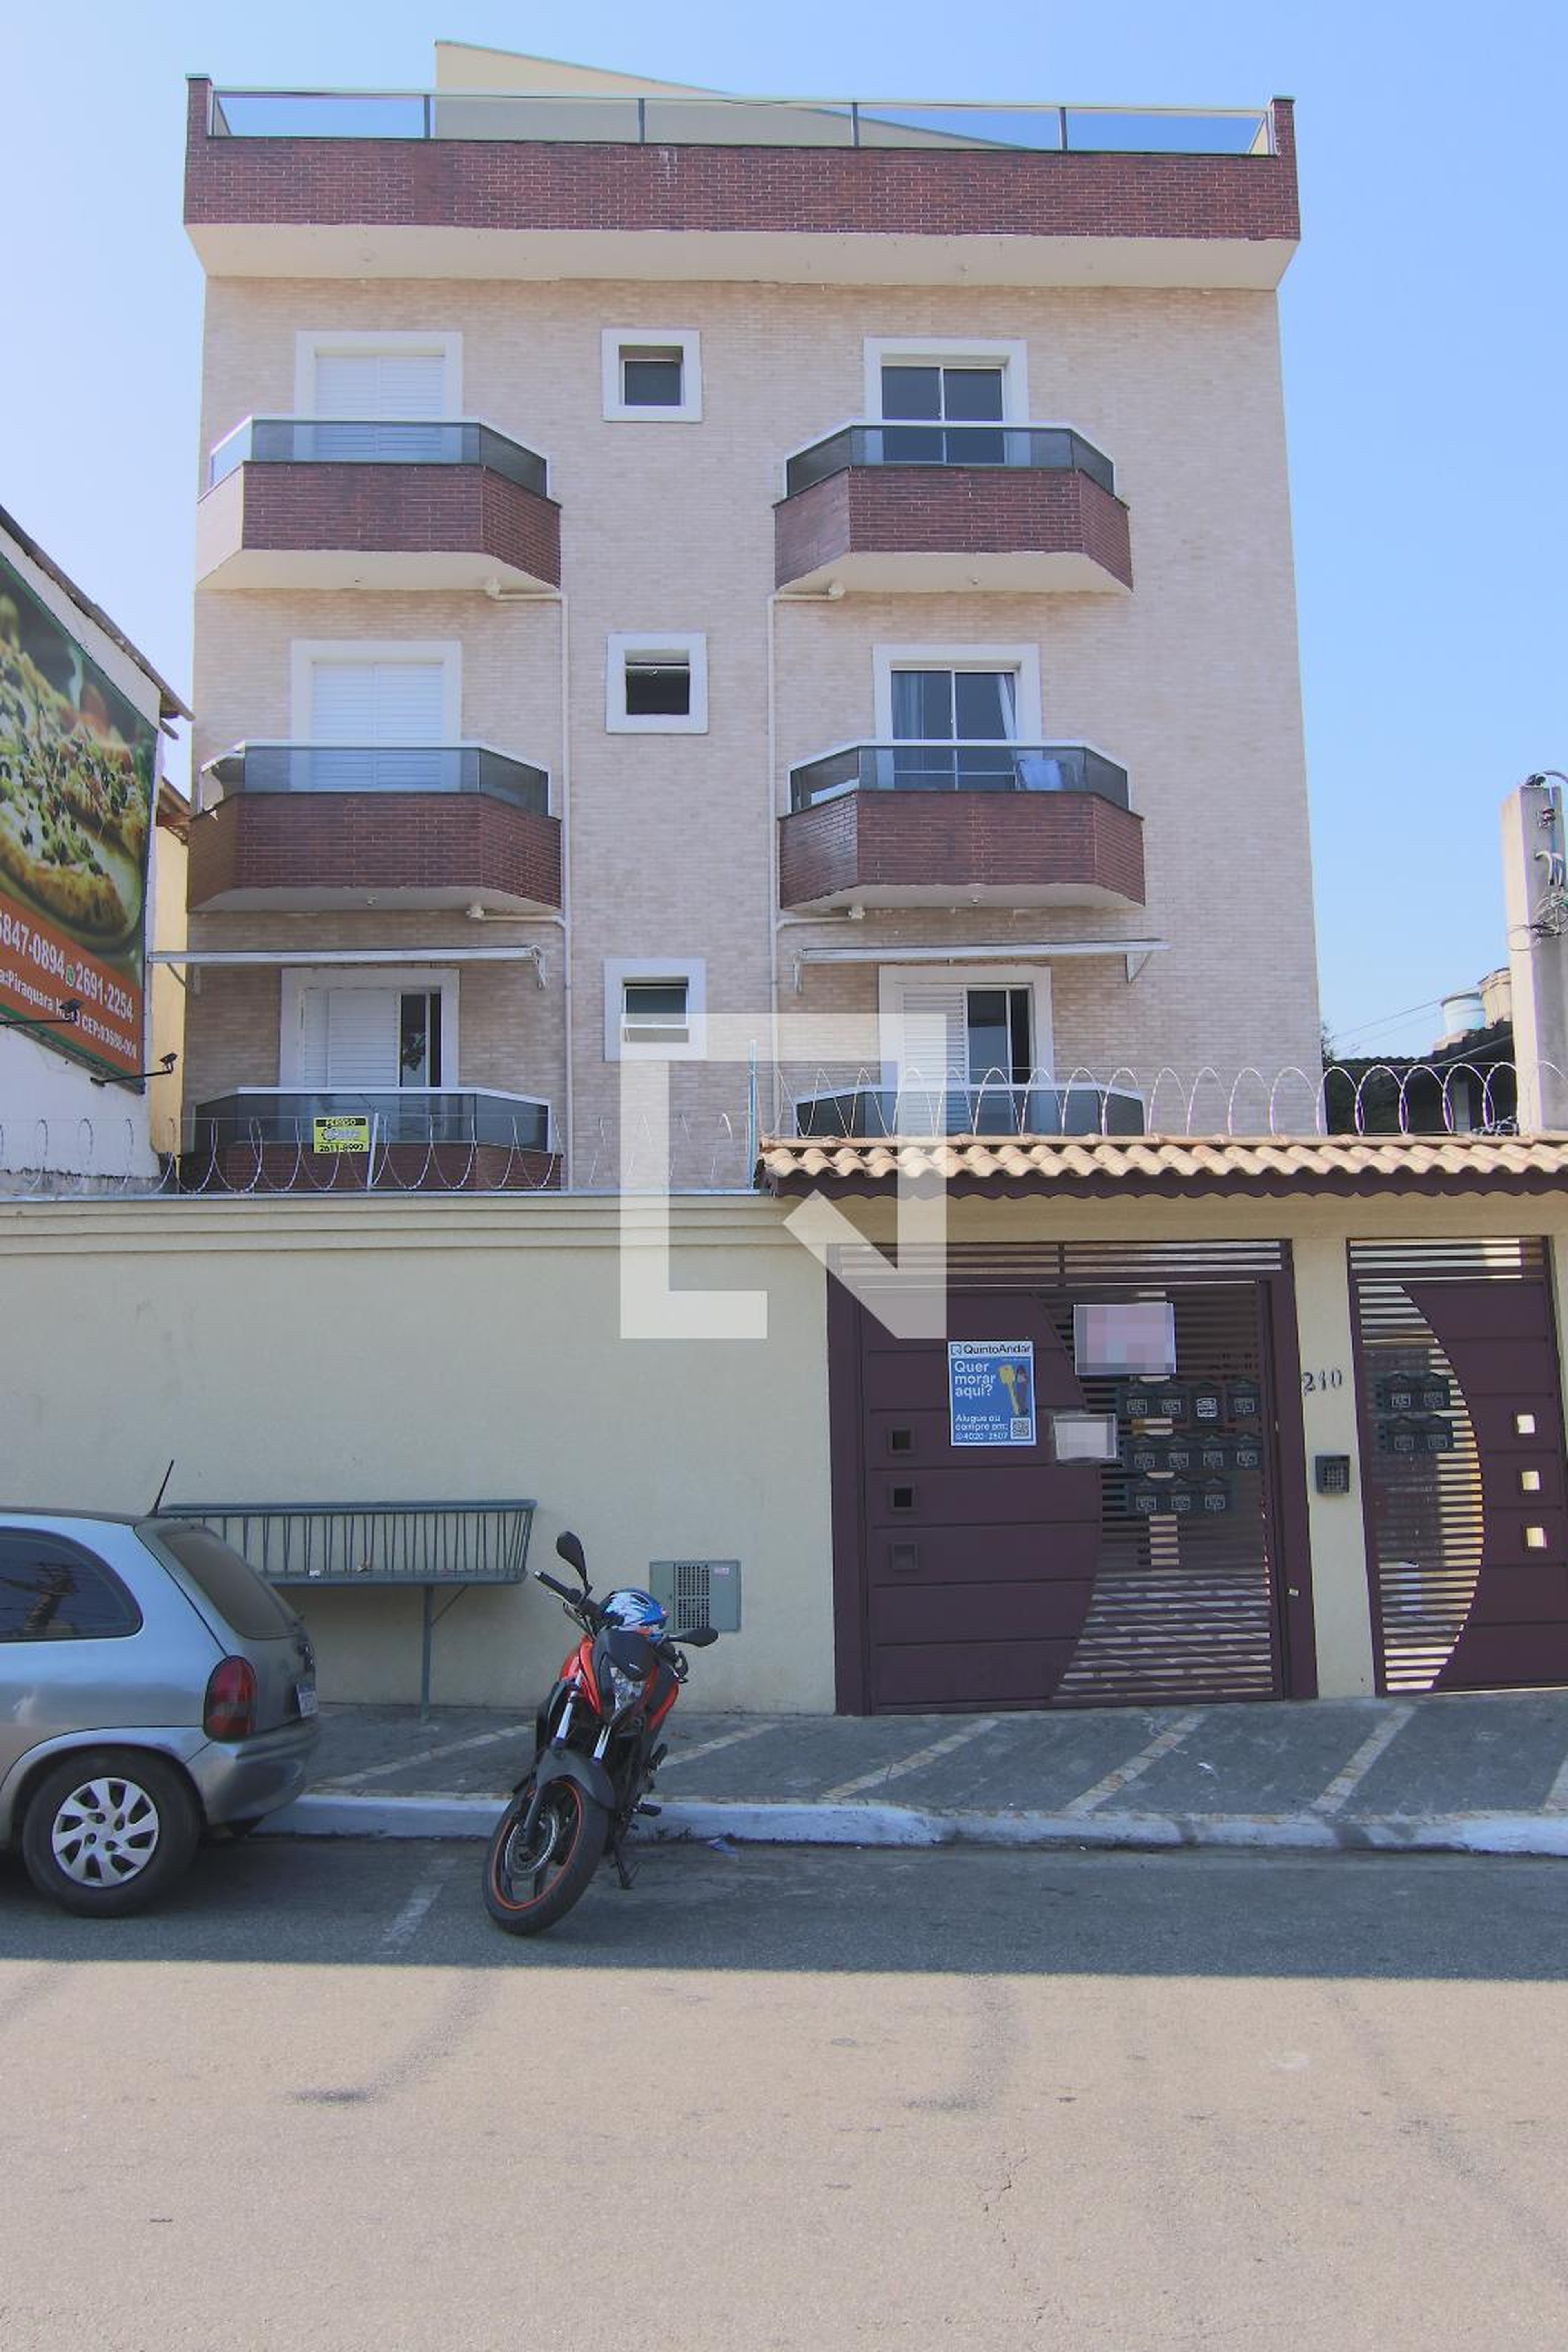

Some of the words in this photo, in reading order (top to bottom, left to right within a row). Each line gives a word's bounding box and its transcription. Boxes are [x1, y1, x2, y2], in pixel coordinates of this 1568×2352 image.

[964, 1344, 1030, 1354] QuintoAndar
[955, 1361, 989, 1373] Quer
[955, 1374, 995, 1385] morar
[955, 1384, 993, 1400] aqui?
[956, 1414, 987, 1423] Alugue
